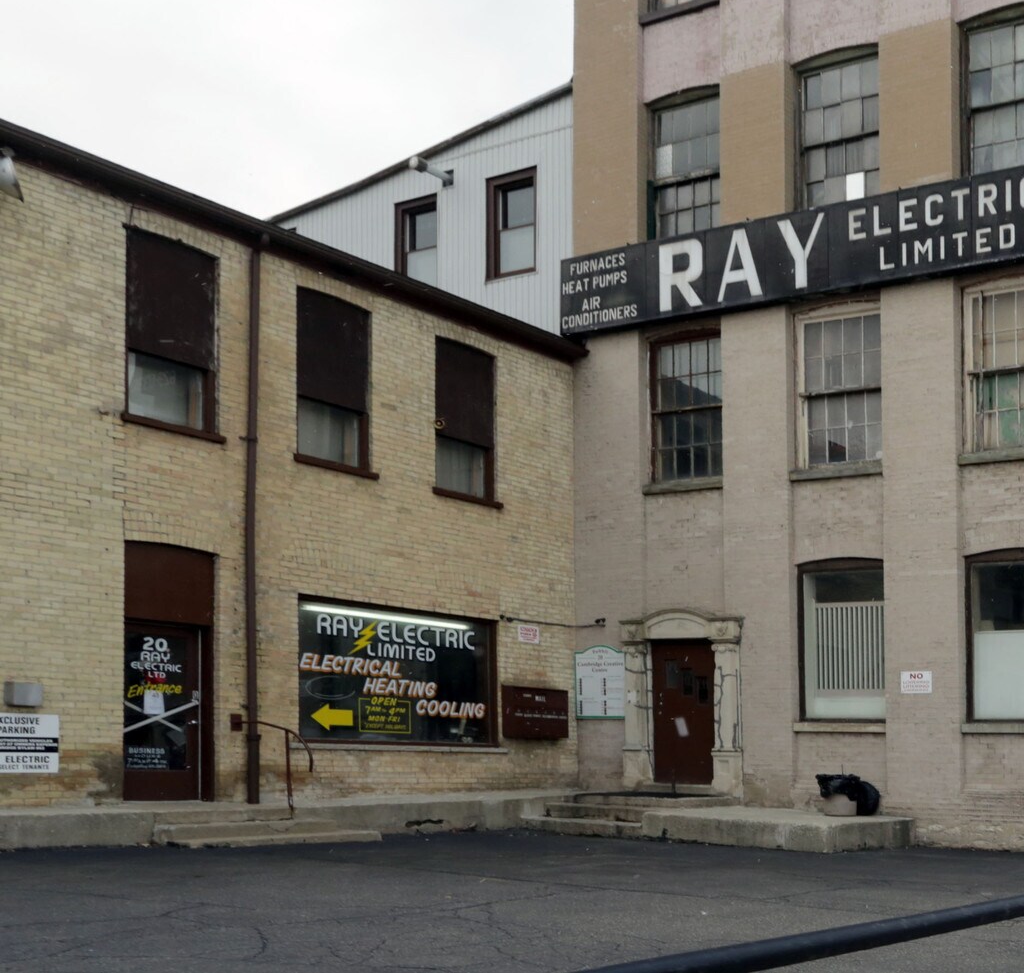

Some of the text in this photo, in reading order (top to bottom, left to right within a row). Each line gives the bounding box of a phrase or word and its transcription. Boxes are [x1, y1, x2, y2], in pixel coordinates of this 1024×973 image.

[879, 223, 1016, 270] LIMITED
[570, 252, 626, 276] FURNACES
[659, 212, 825, 312] RAY
[562, 270, 627, 295] HEAT PUMPS
[582, 296, 601, 312] AIR
[561, 304, 638, 329] CONDITIONERS
[316, 614, 476, 651] RAY ELECTRIC
[142, 636, 169, 653] 20
[366, 642, 437, 663] LIMITED
[140, 651, 171, 664] RAY
[300, 652, 402, 677] ELECTRICAL
[130, 661, 182, 674] ELECTRIC
[148, 671, 167, 679] LTD
[127, 683, 183, 699] Entrance
[363, 677, 438, 698] HEATING
[371, 696, 398, 707] OPEN
[415, 699, 486, 718] COOLING
[5, 755, 50, 763] ELECTRIC
[128, 746, 165, 755] BUSINESS
